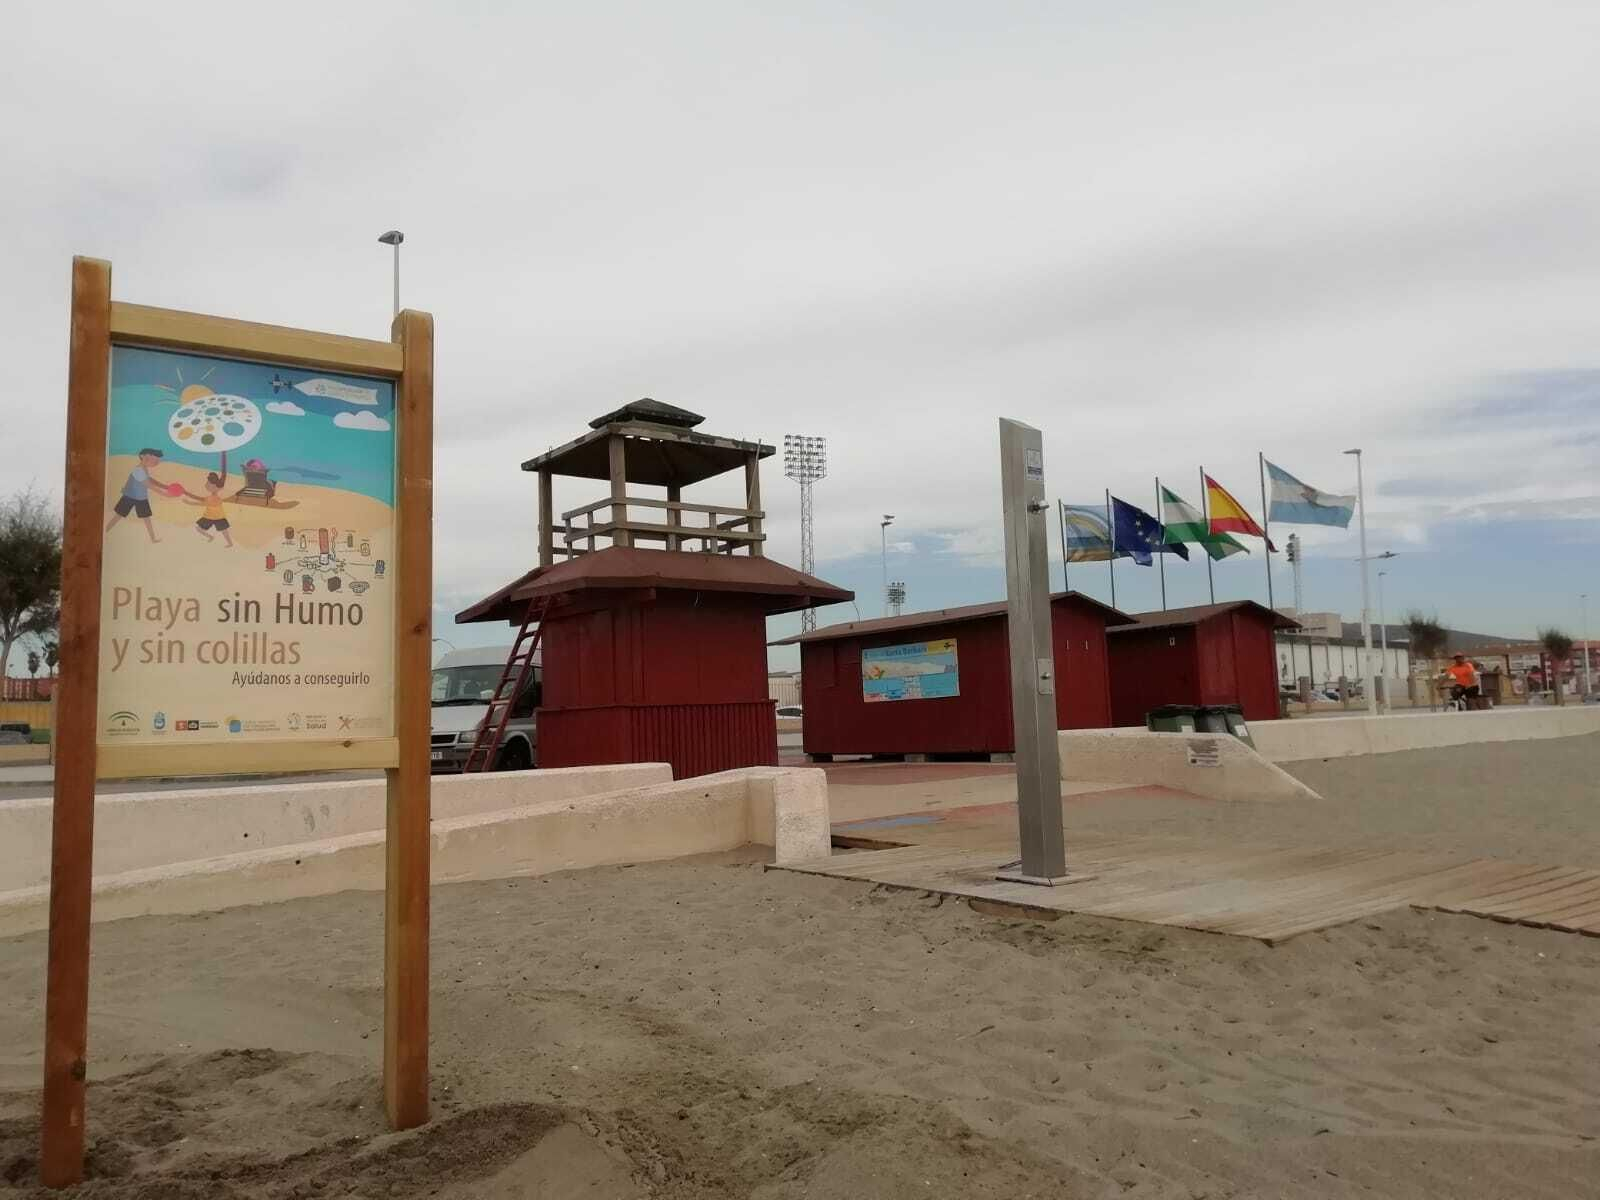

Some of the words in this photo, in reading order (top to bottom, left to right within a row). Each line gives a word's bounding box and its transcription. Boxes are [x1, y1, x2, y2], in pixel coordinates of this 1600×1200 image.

[112, 587, 200, 630] Playa
[217, 592, 261, 623] sin
[276, 593, 363, 626] Humo
[112, 637, 130, 672] y
[140, 632, 184, 664] sin
[197, 631, 301, 665] colillas
[232, 671, 291, 687] Ayúdanos
[295, 676, 301, 685] a
[304, 672, 370, 687] conseguirlo
